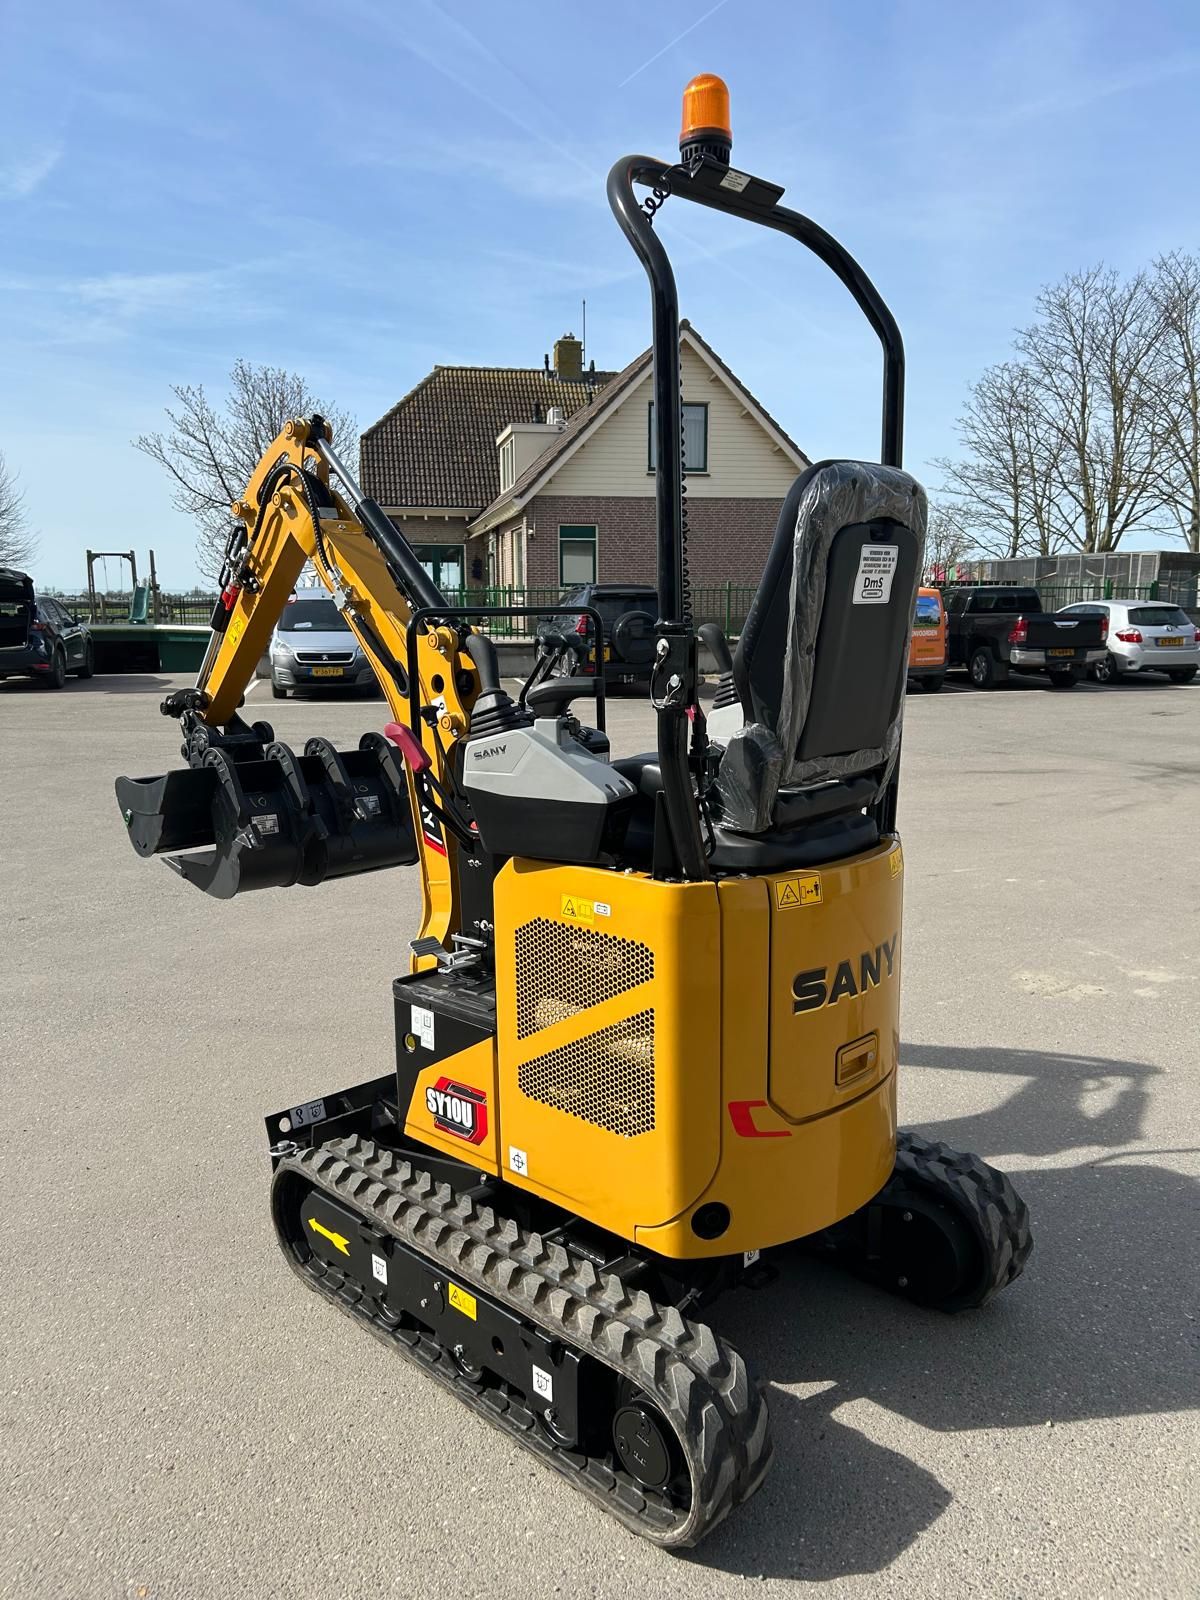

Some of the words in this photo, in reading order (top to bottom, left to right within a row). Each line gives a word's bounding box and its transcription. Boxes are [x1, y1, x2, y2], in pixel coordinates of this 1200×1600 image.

[864, 577, 884, 588] DmS
[474, 744, 507, 760] SANY
[791, 938, 897, 1015] SANY
[426, 1088, 473, 1128] SY10U
